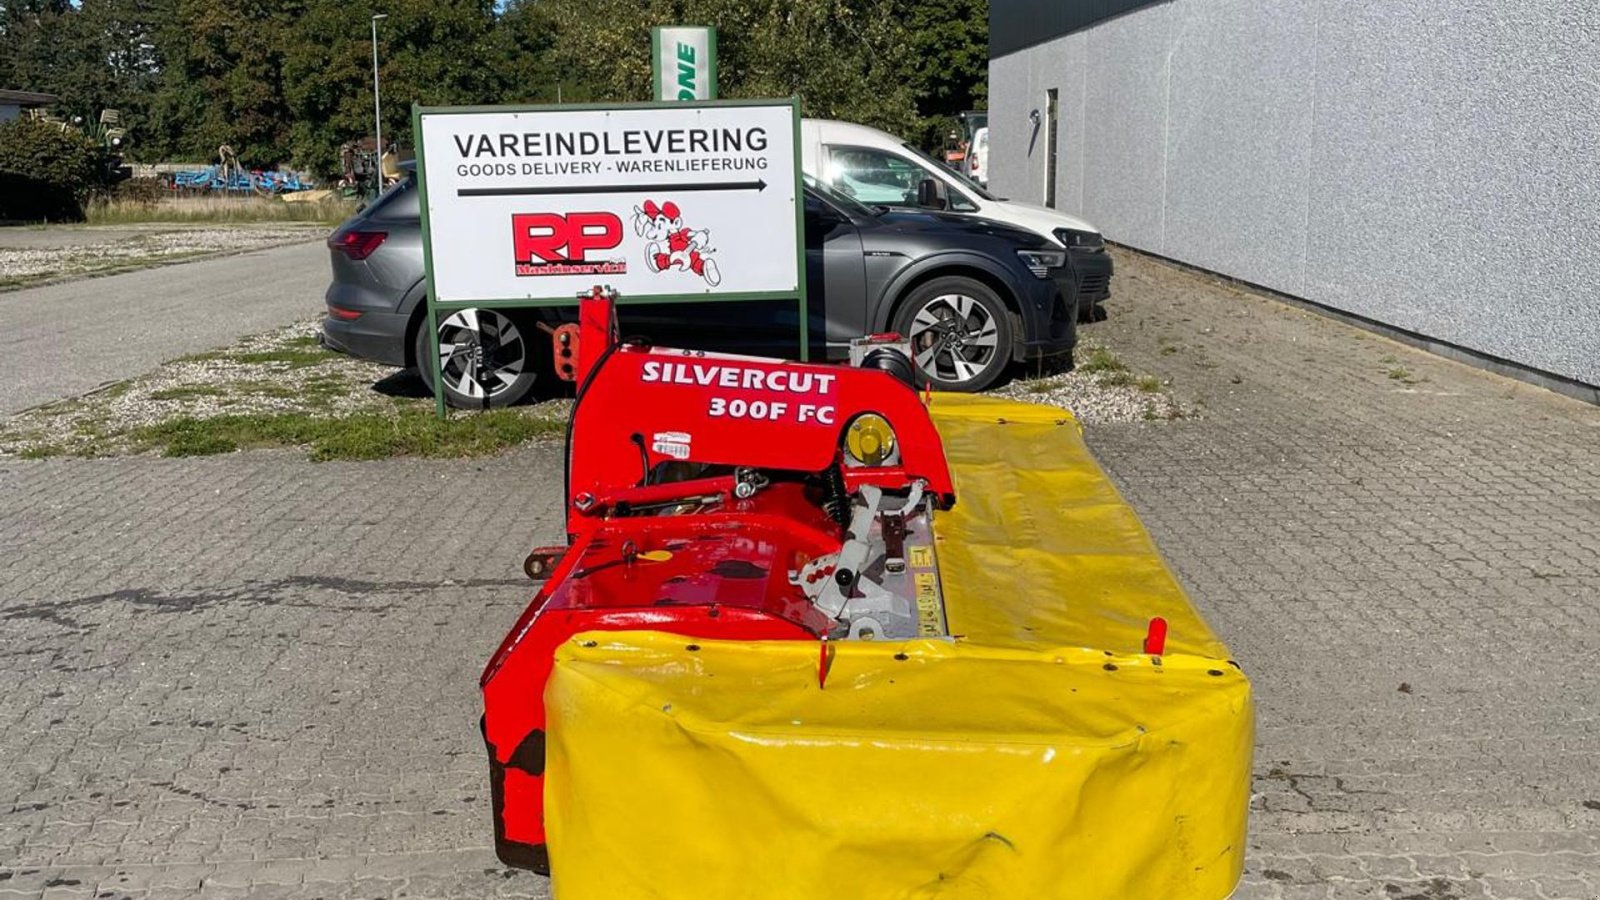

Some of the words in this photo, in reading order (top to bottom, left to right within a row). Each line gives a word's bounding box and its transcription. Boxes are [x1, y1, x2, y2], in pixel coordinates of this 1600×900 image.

[453, 127, 768, 158] VAREINDLEVERING
[456, 163, 517, 177] GOODS
[522, 160, 602, 175] DELIVERY
[615, 157, 768, 173] WARENLIEFERUNG
[512, 211, 623, 262] RP
[516, 262, 627, 275] Maskinservice
[641, 360, 836, 394] SILVERCUT
[708, 397, 788, 421] 300F
[797, 404, 835, 425] FC
